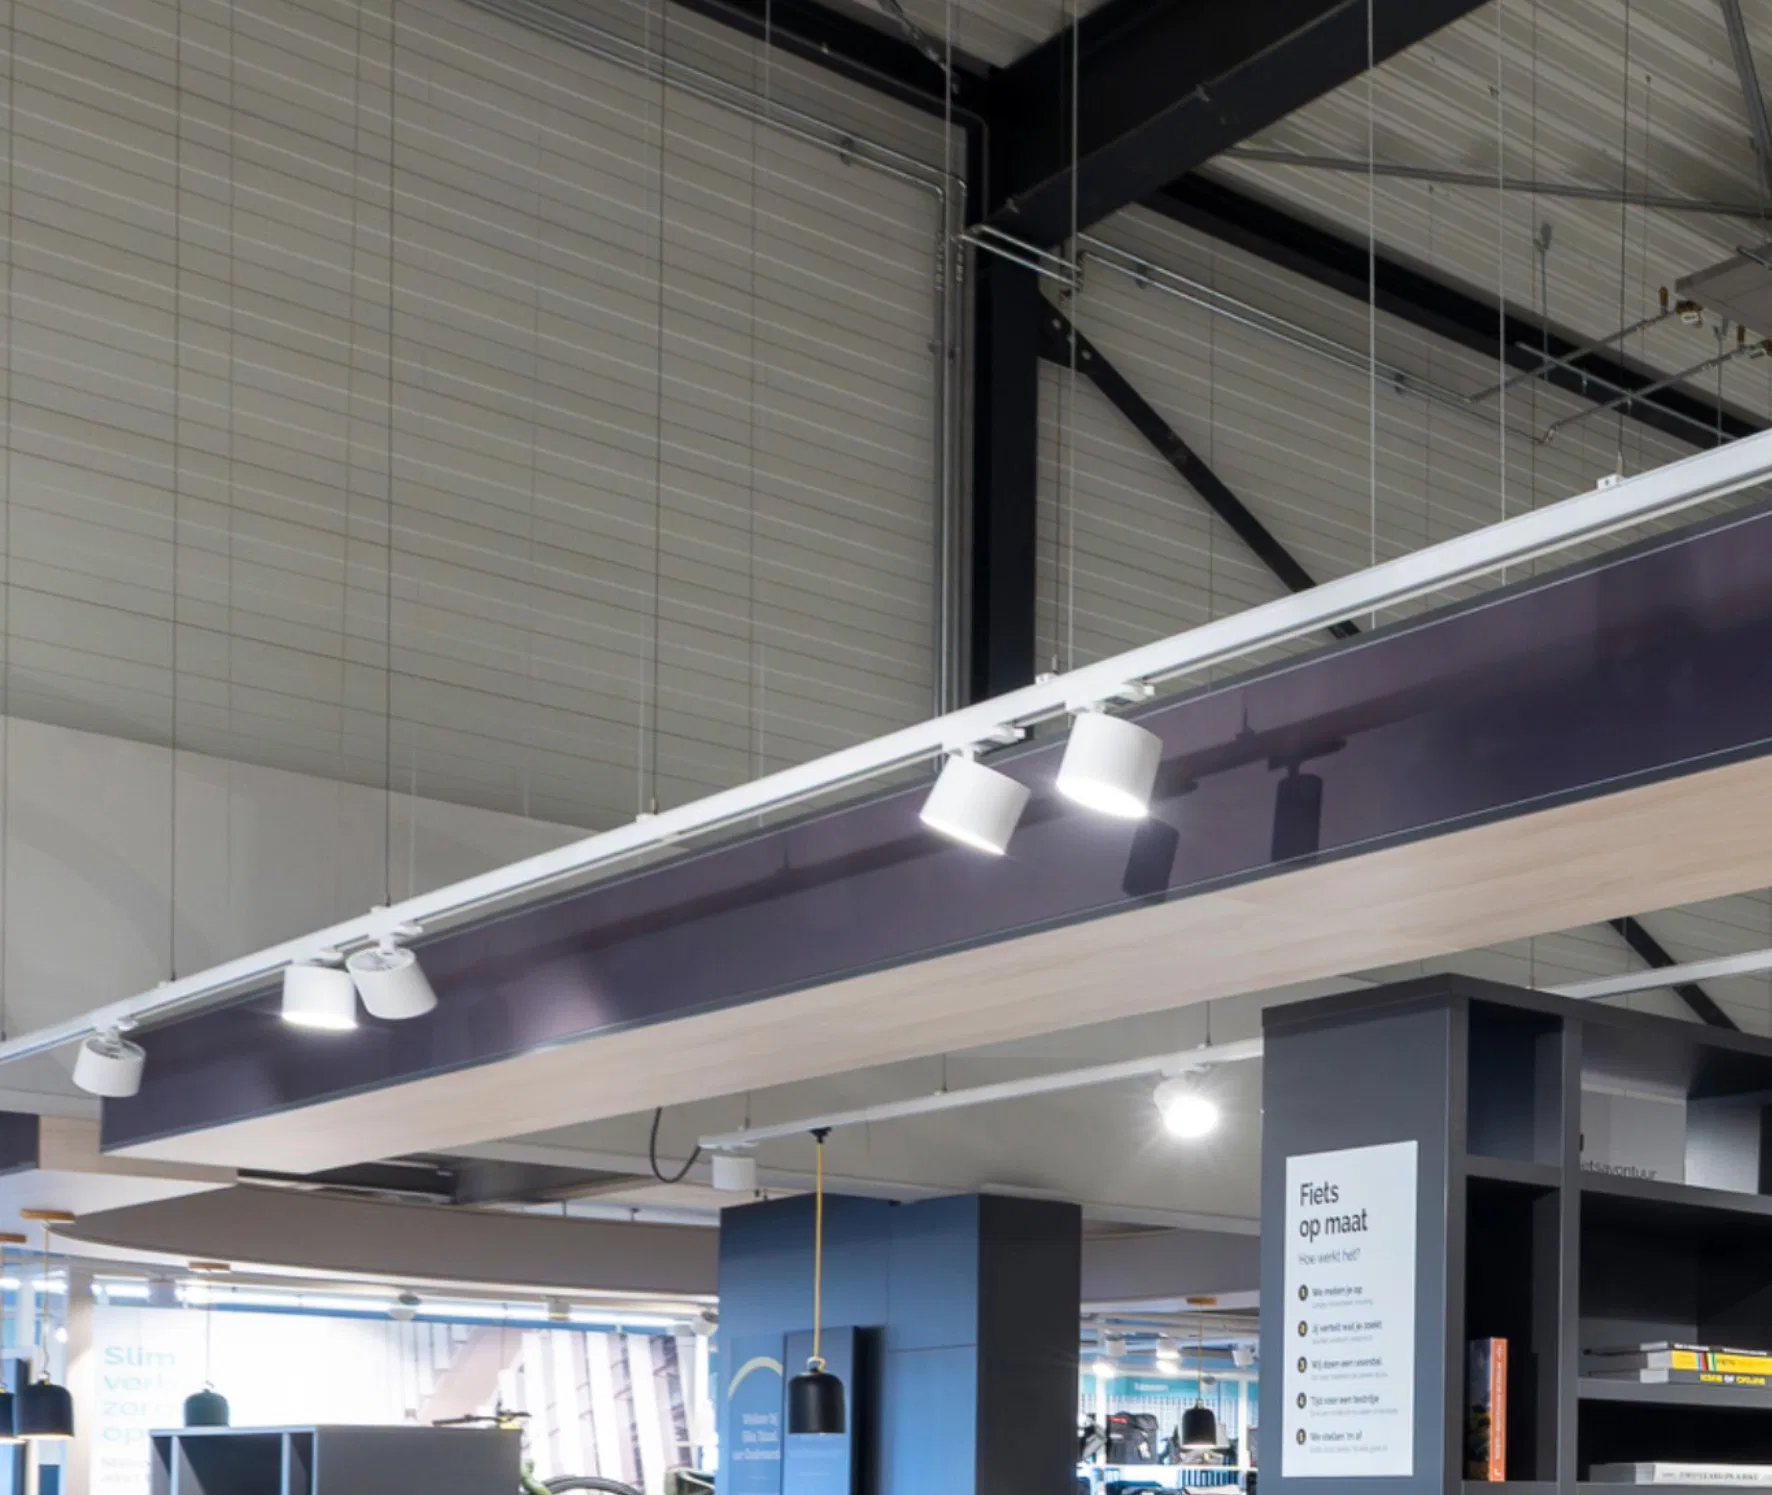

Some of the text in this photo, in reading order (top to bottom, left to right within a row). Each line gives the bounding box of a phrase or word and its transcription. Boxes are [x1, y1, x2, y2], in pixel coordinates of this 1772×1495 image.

[1299, 1181, 1340, 1206] Fiets
[1299, 1208, 1369, 1243] op maat
[104, 1345, 176, 1366] Slim
